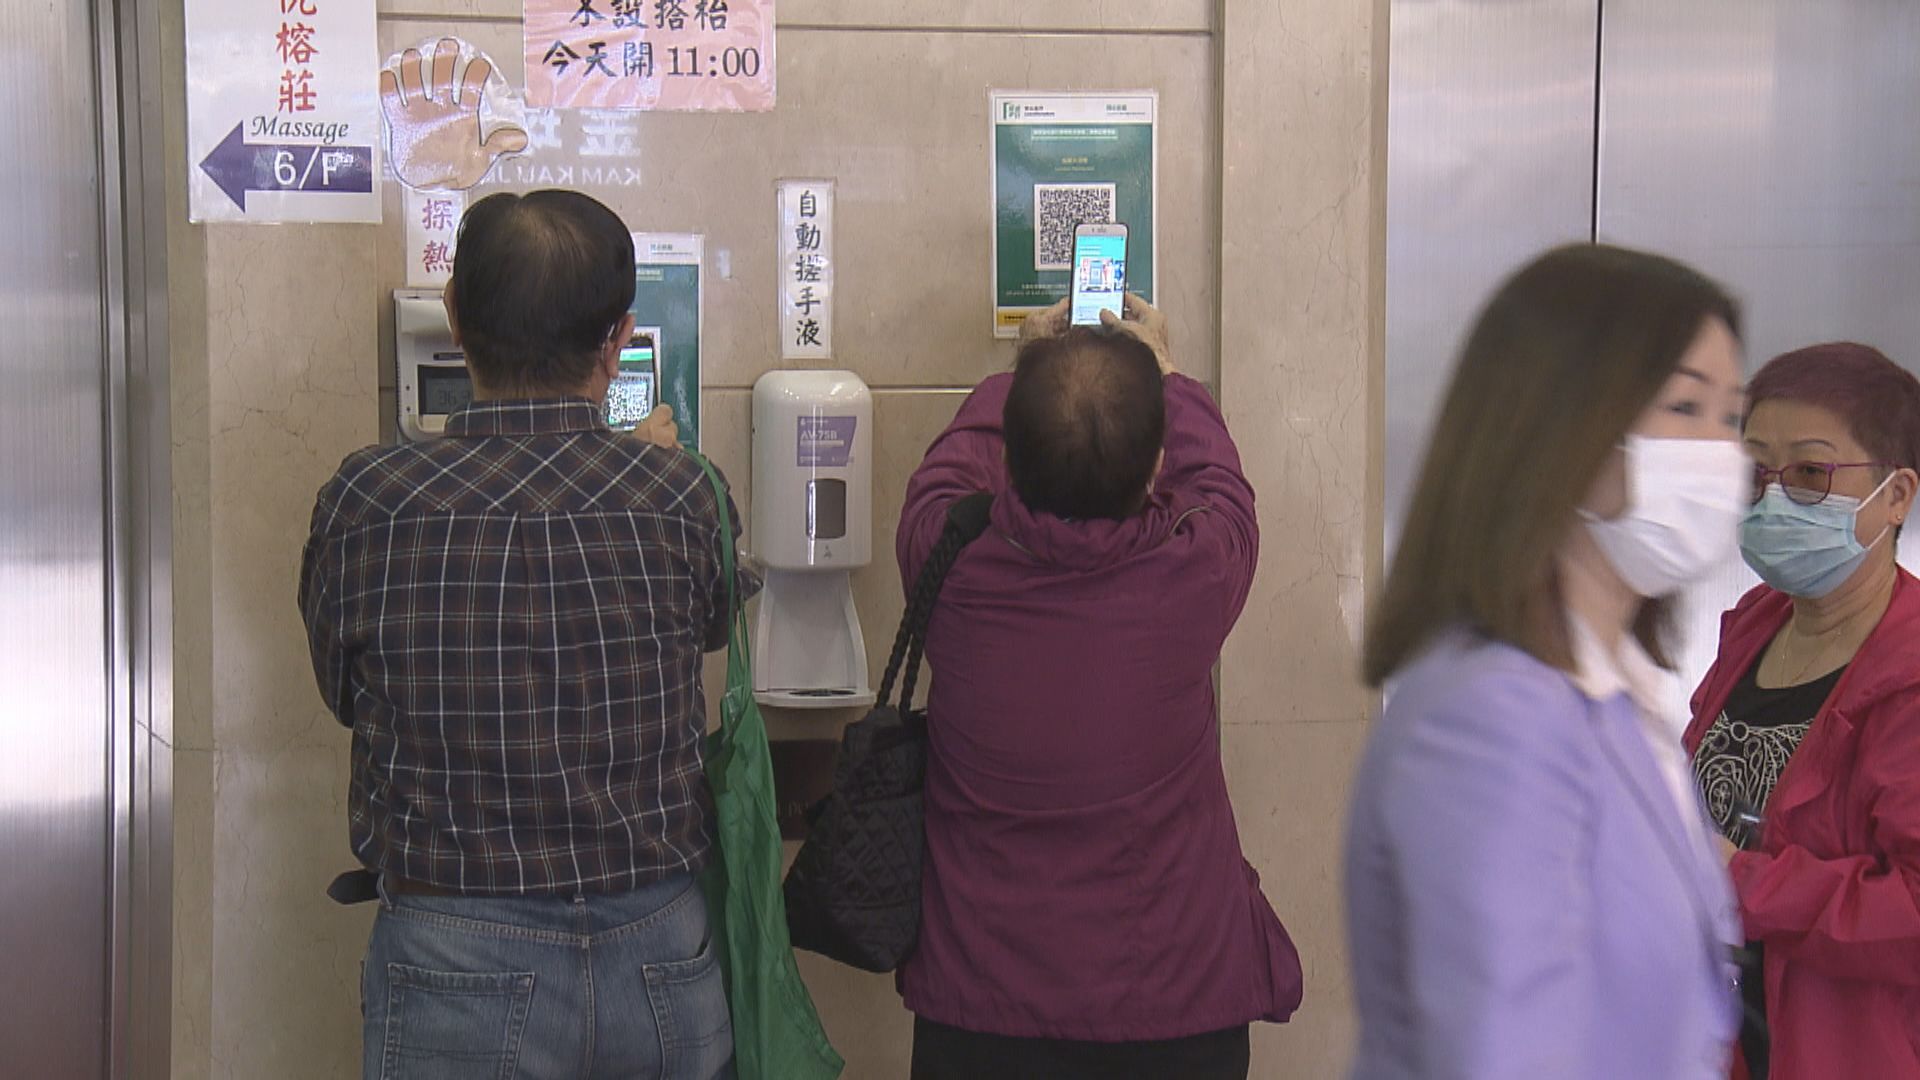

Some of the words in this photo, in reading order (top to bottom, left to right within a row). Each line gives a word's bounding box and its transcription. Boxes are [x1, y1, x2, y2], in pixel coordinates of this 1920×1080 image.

[542, 40, 654, 78] 今天開
[666, 46, 761, 77] 11:00
[250, 115, 350, 144] Massage
[422, 198, 454, 273] 探熱
